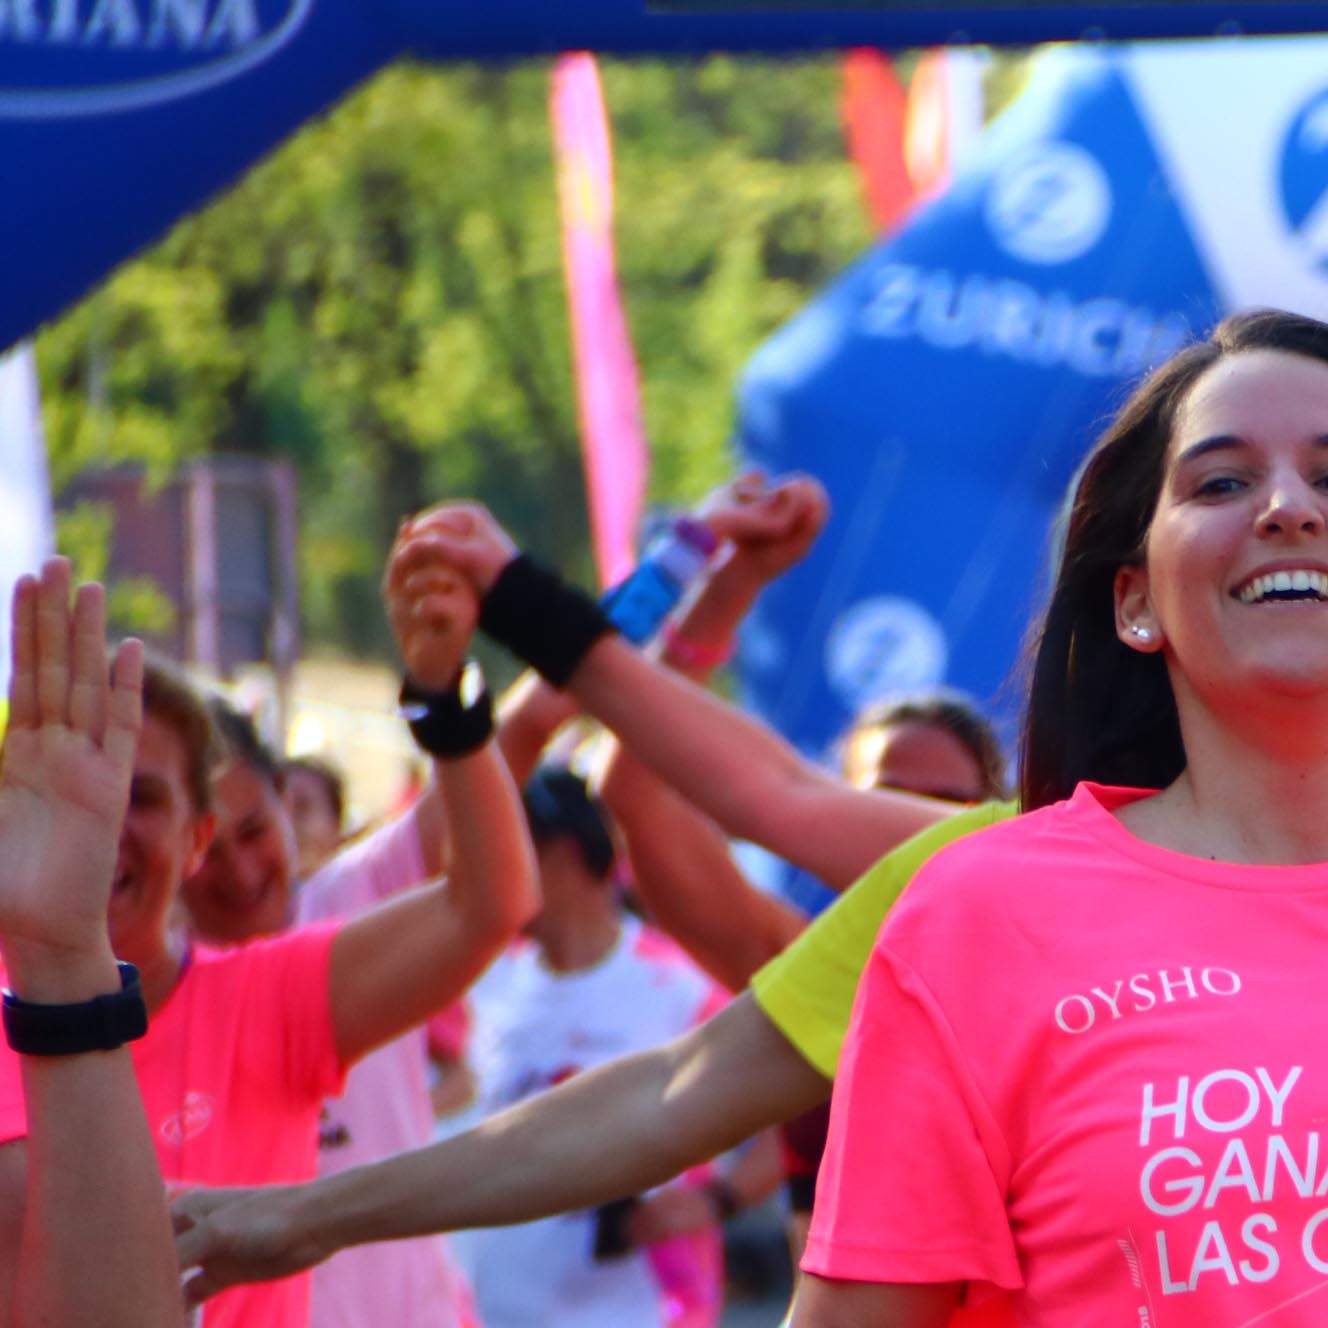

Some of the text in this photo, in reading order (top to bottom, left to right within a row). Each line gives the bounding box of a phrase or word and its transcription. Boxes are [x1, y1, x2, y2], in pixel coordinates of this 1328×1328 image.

[1054, 966, 1242, 1034] OYSHO
[1139, 1066, 1303, 1146] HOY
[1155, 1213, 1280, 1295] LAS
